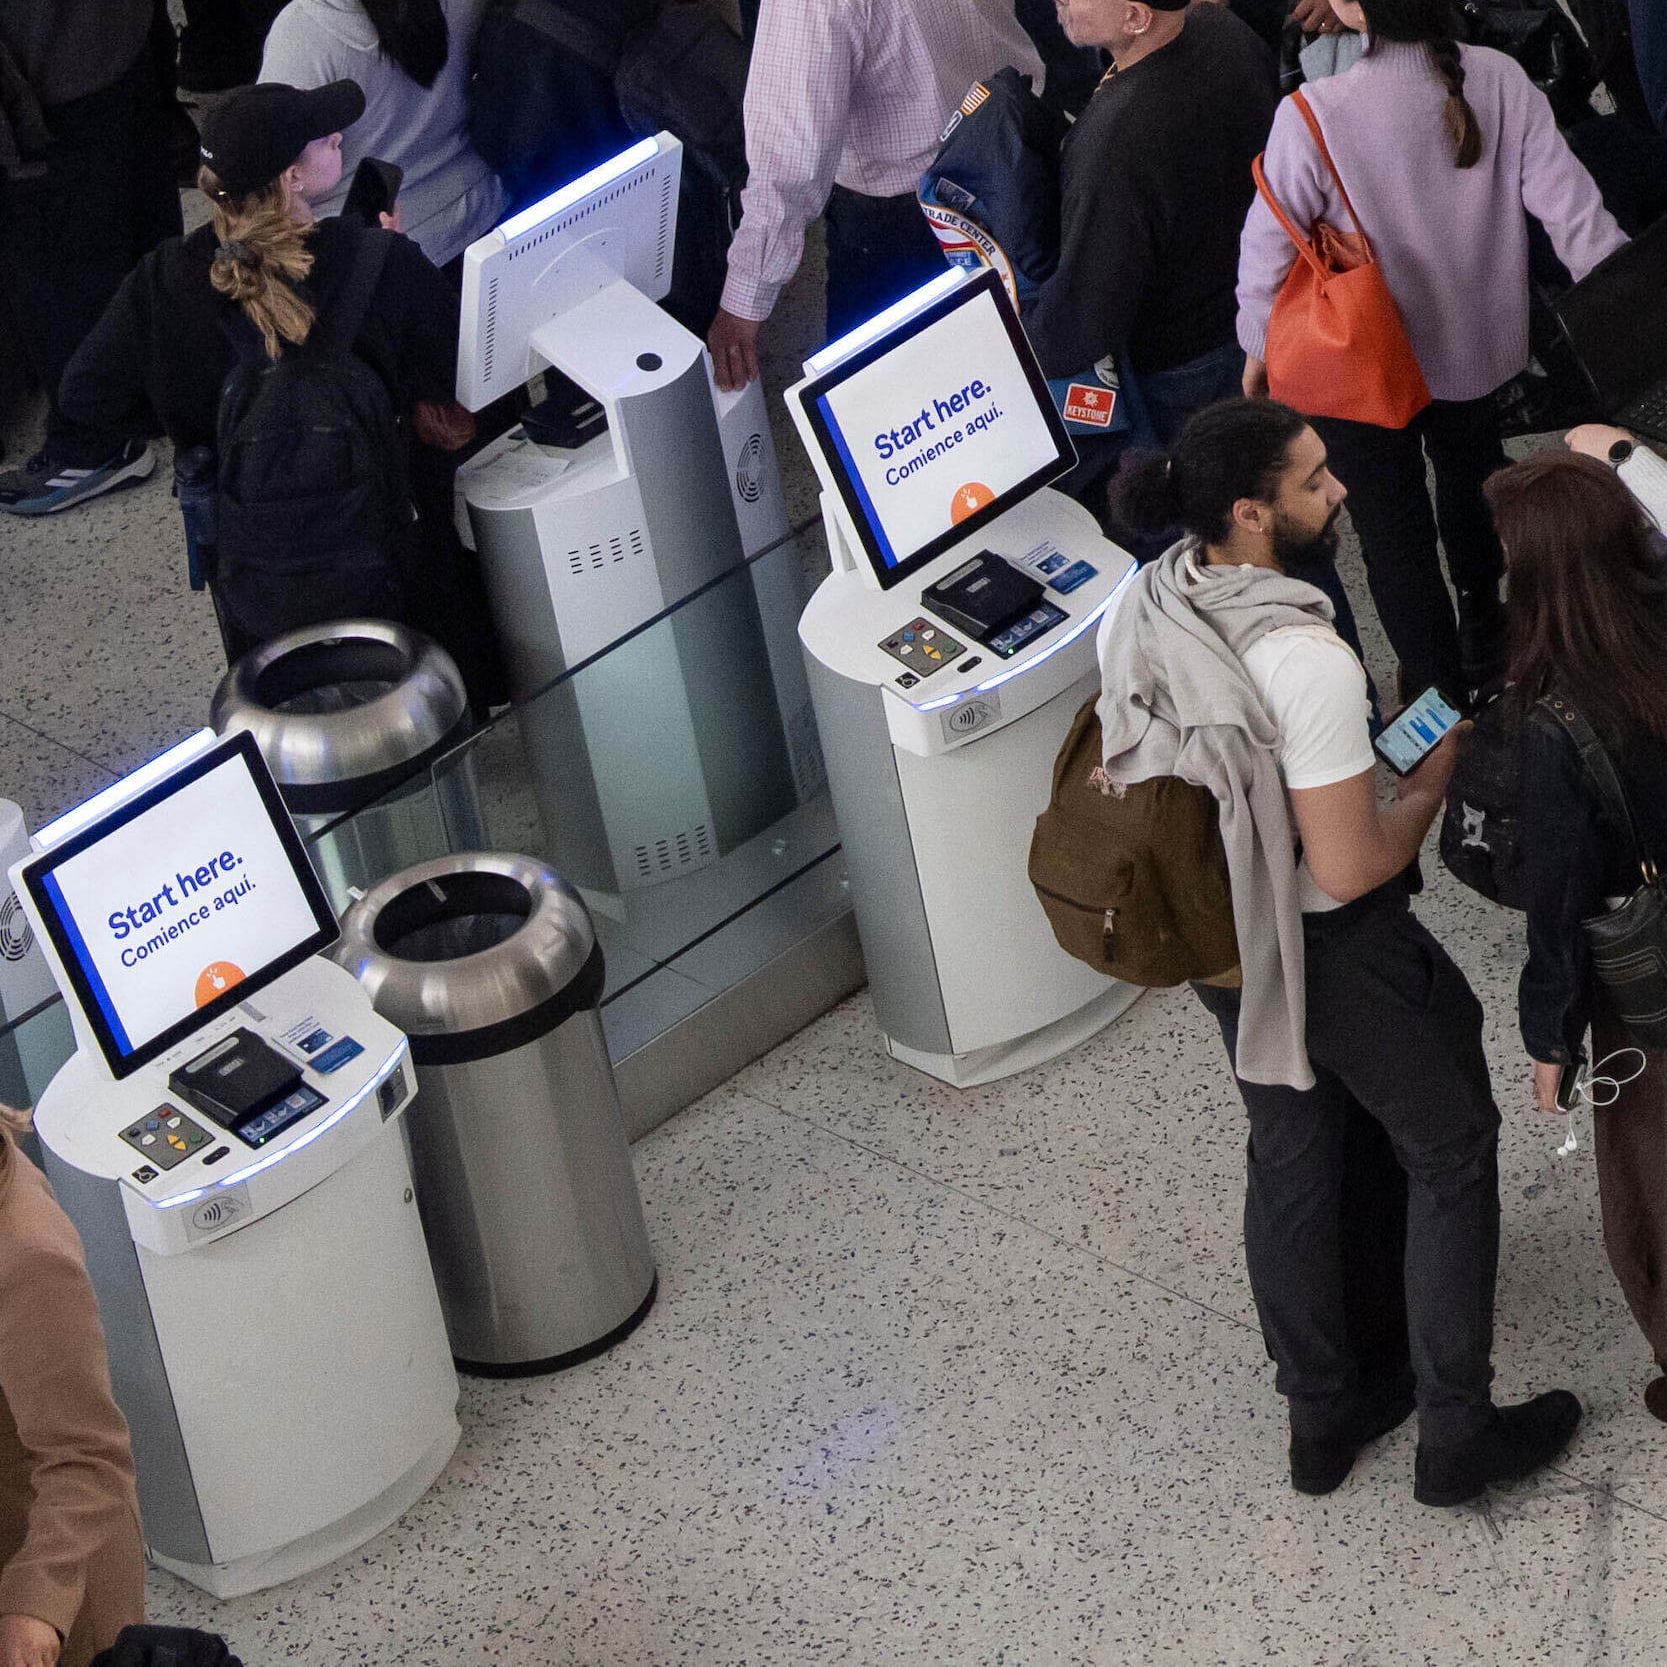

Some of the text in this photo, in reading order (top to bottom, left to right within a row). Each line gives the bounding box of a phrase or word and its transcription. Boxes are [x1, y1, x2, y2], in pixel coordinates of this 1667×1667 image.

[924, 207, 957, 226] TRADE
[960, 222, 997, 257] CENTER
[874, 379, 992, 460] Start here.
[886, 401, 1004, 486] Comience aquí.
[1067, 405, 1108, 423] KEYSTONE
[108, 850, 243, 940] Start here.
[121, 873, 256, 968] Comience aquí.
